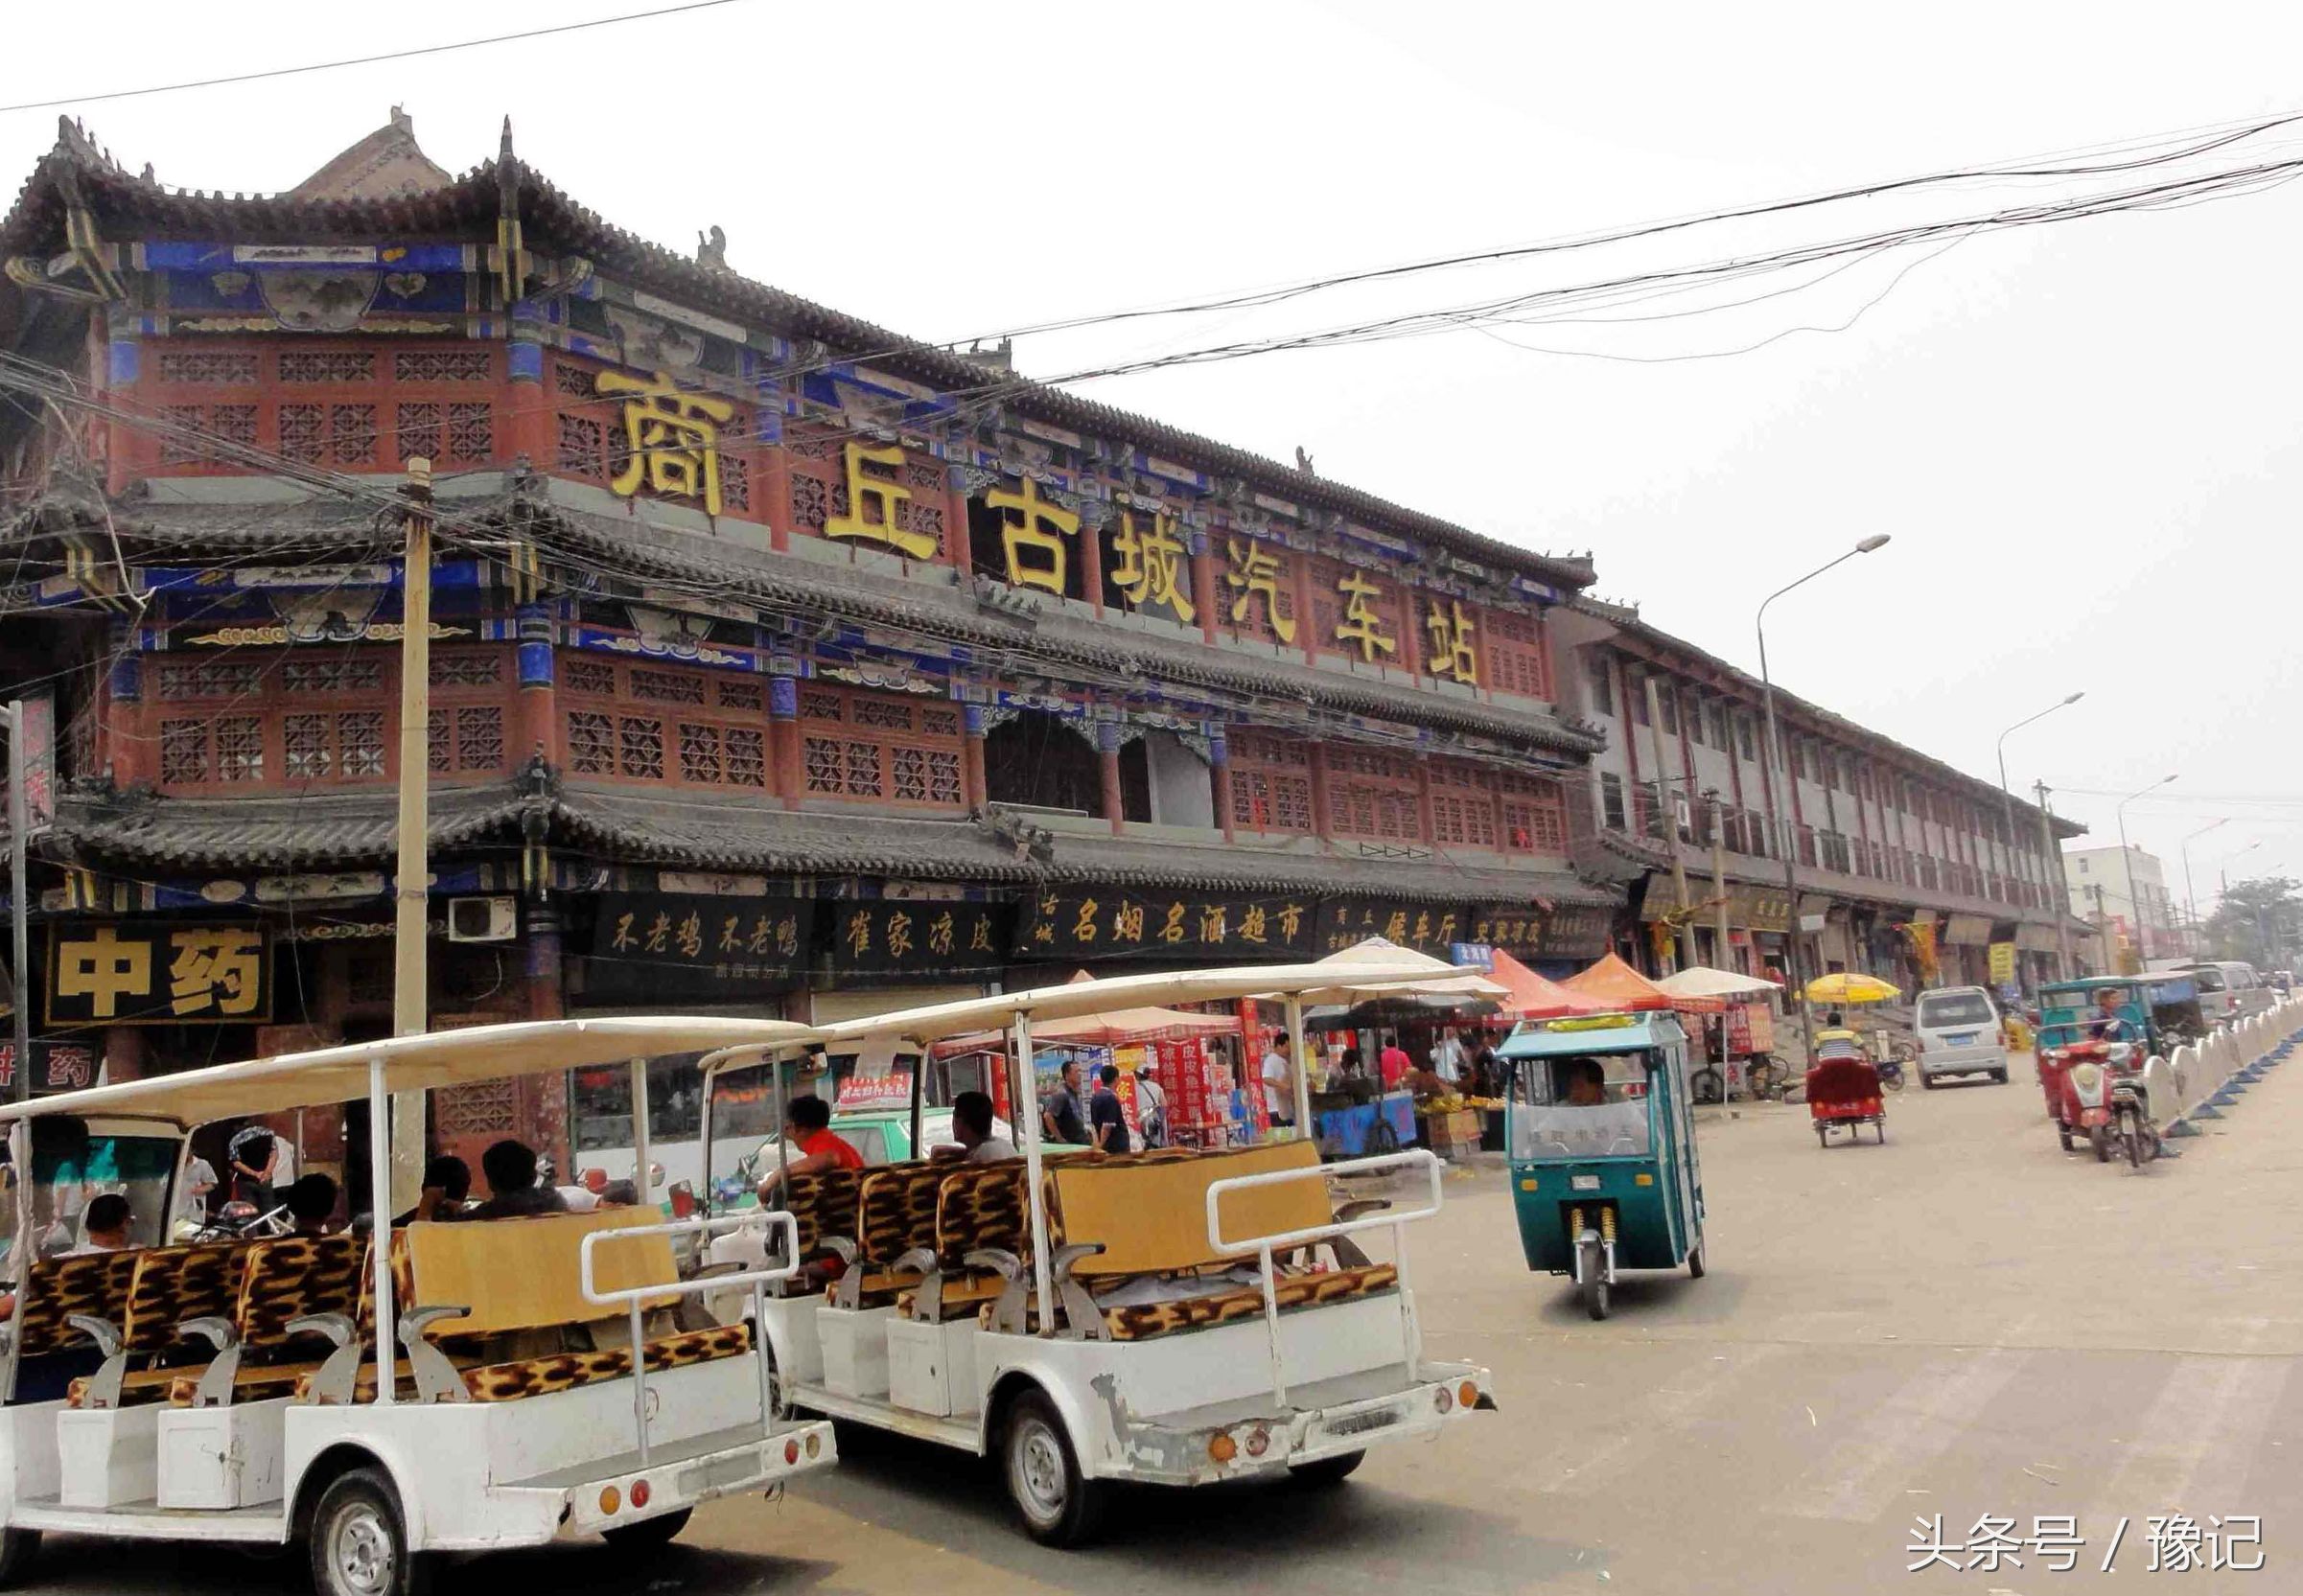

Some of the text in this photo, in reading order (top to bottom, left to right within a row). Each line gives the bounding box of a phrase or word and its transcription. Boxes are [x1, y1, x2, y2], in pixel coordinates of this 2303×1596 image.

[596, 370, 1477, 684] 商丘古城汽车站
[1035, 892, 1059, 944] 古城
[1072, 897, 1304, 945] 名烟名酒超市
[1385, 910, 1456, 951] 候车厅
[58, 927, 263, 1017] 中药
